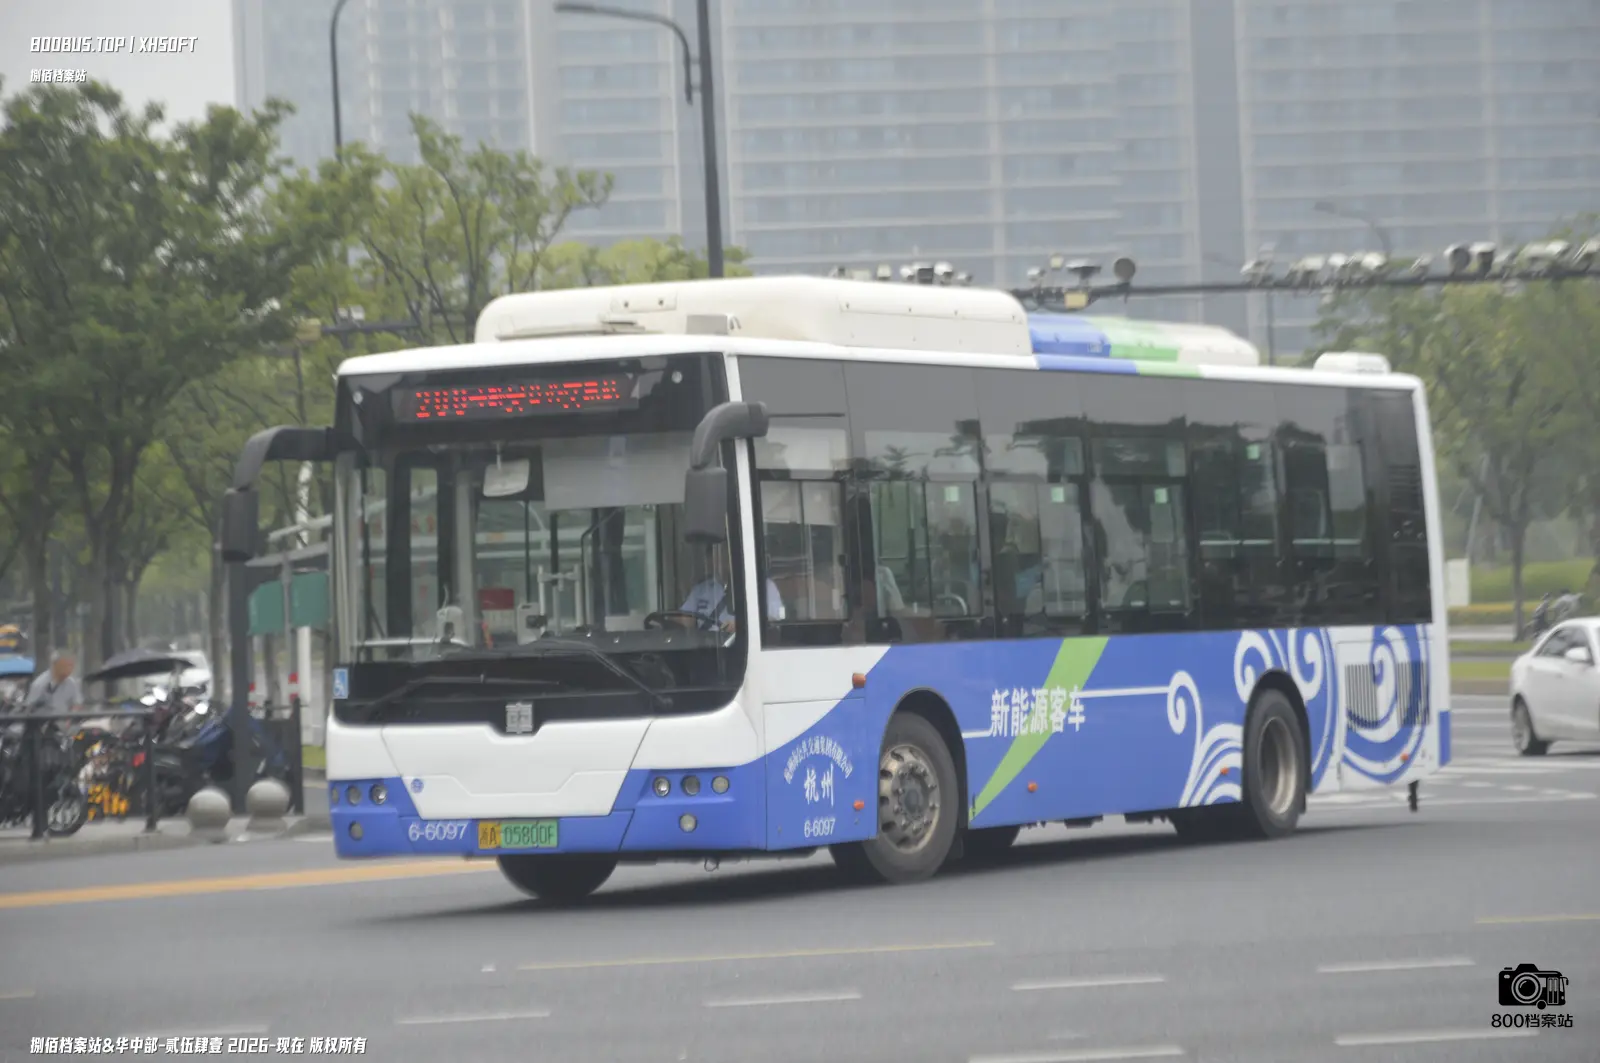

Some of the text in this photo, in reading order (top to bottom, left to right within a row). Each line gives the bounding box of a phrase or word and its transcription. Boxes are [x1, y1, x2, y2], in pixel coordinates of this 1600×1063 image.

[990, 684, 1085, 737] 新能源客车
[803, 762, 834, 807] 杭州
[408, 822, 469, 842] 6-6097
[803, 817, 836, 838] 6-6097
